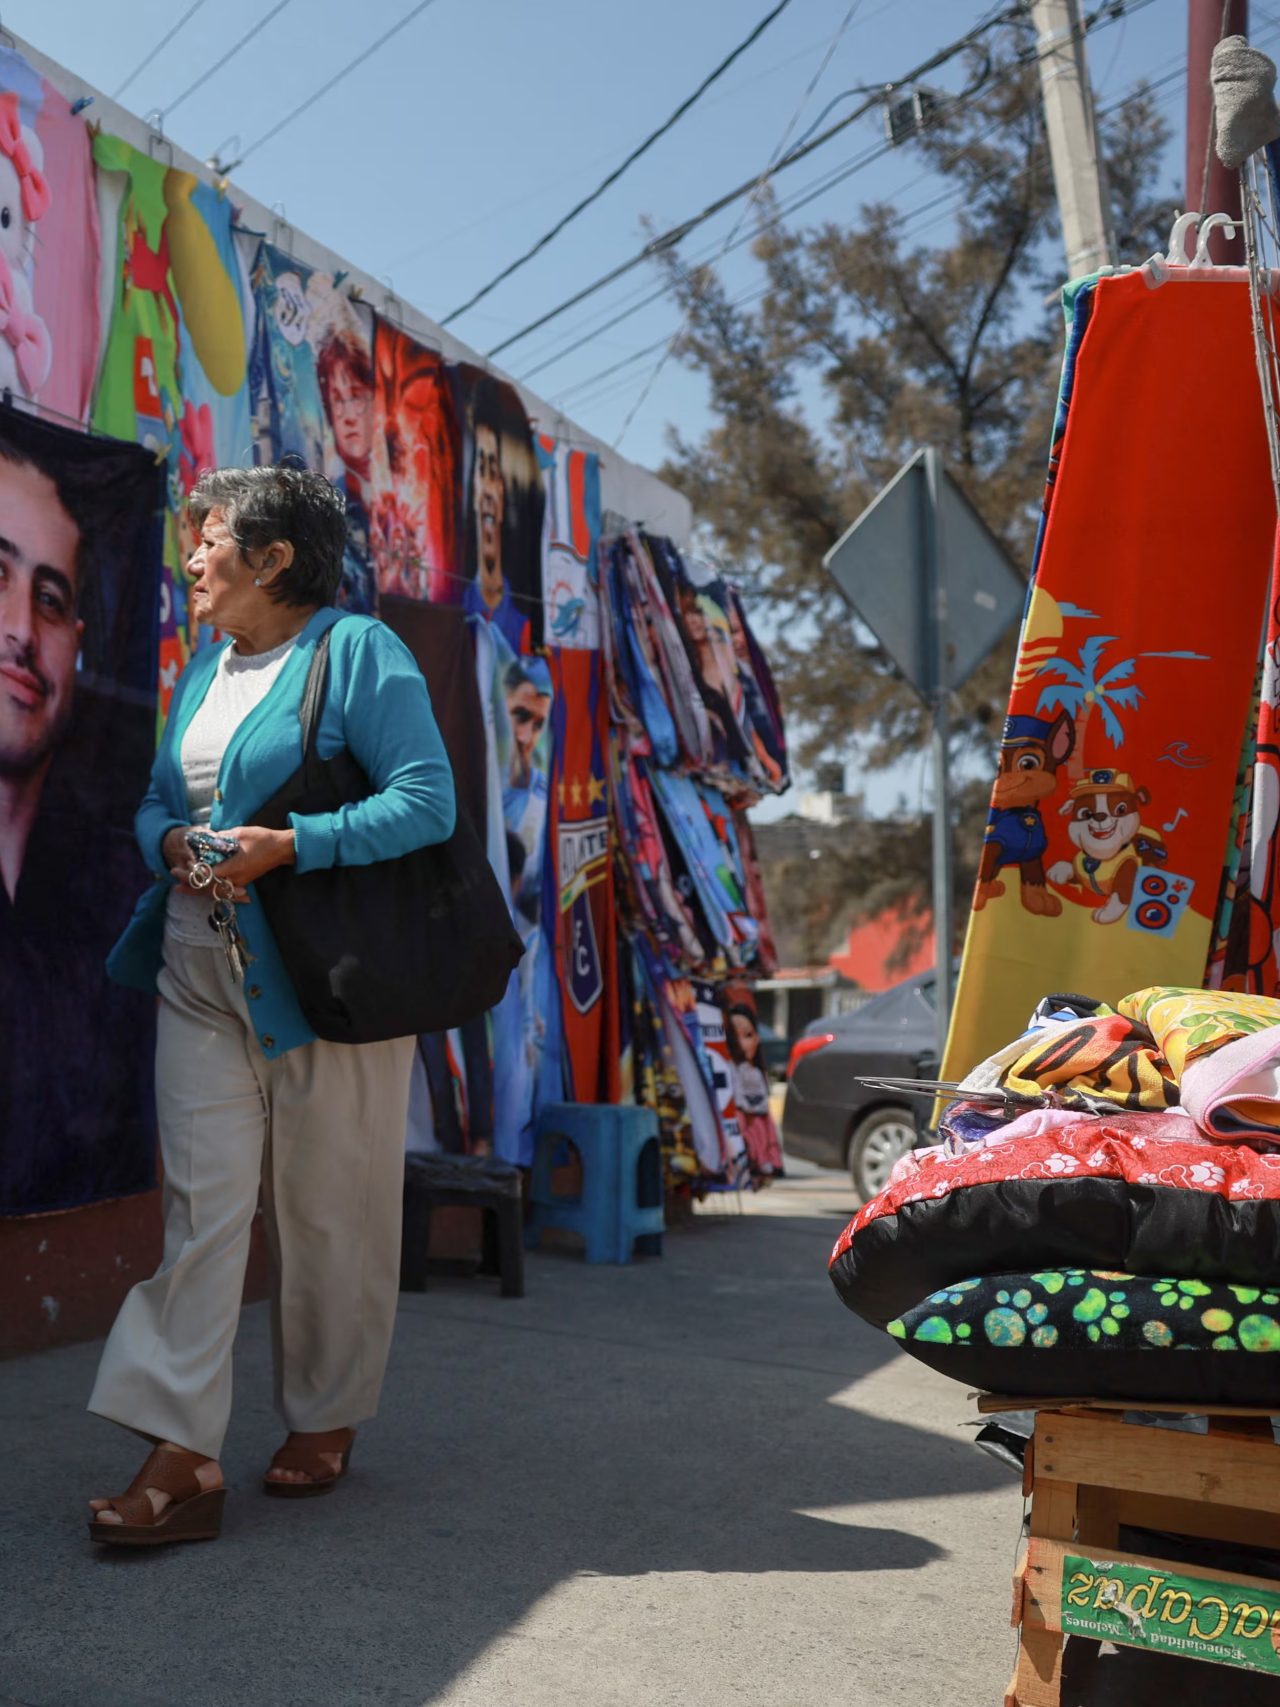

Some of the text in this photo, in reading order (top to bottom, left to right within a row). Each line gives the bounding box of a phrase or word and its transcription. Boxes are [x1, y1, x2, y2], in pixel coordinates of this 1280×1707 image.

[1067, 1571, 1280, 1641] aCapaz
[1066, 1616, 1122, 1637] Melones
[1150, 1632, 1245, 1661] Especialidad
